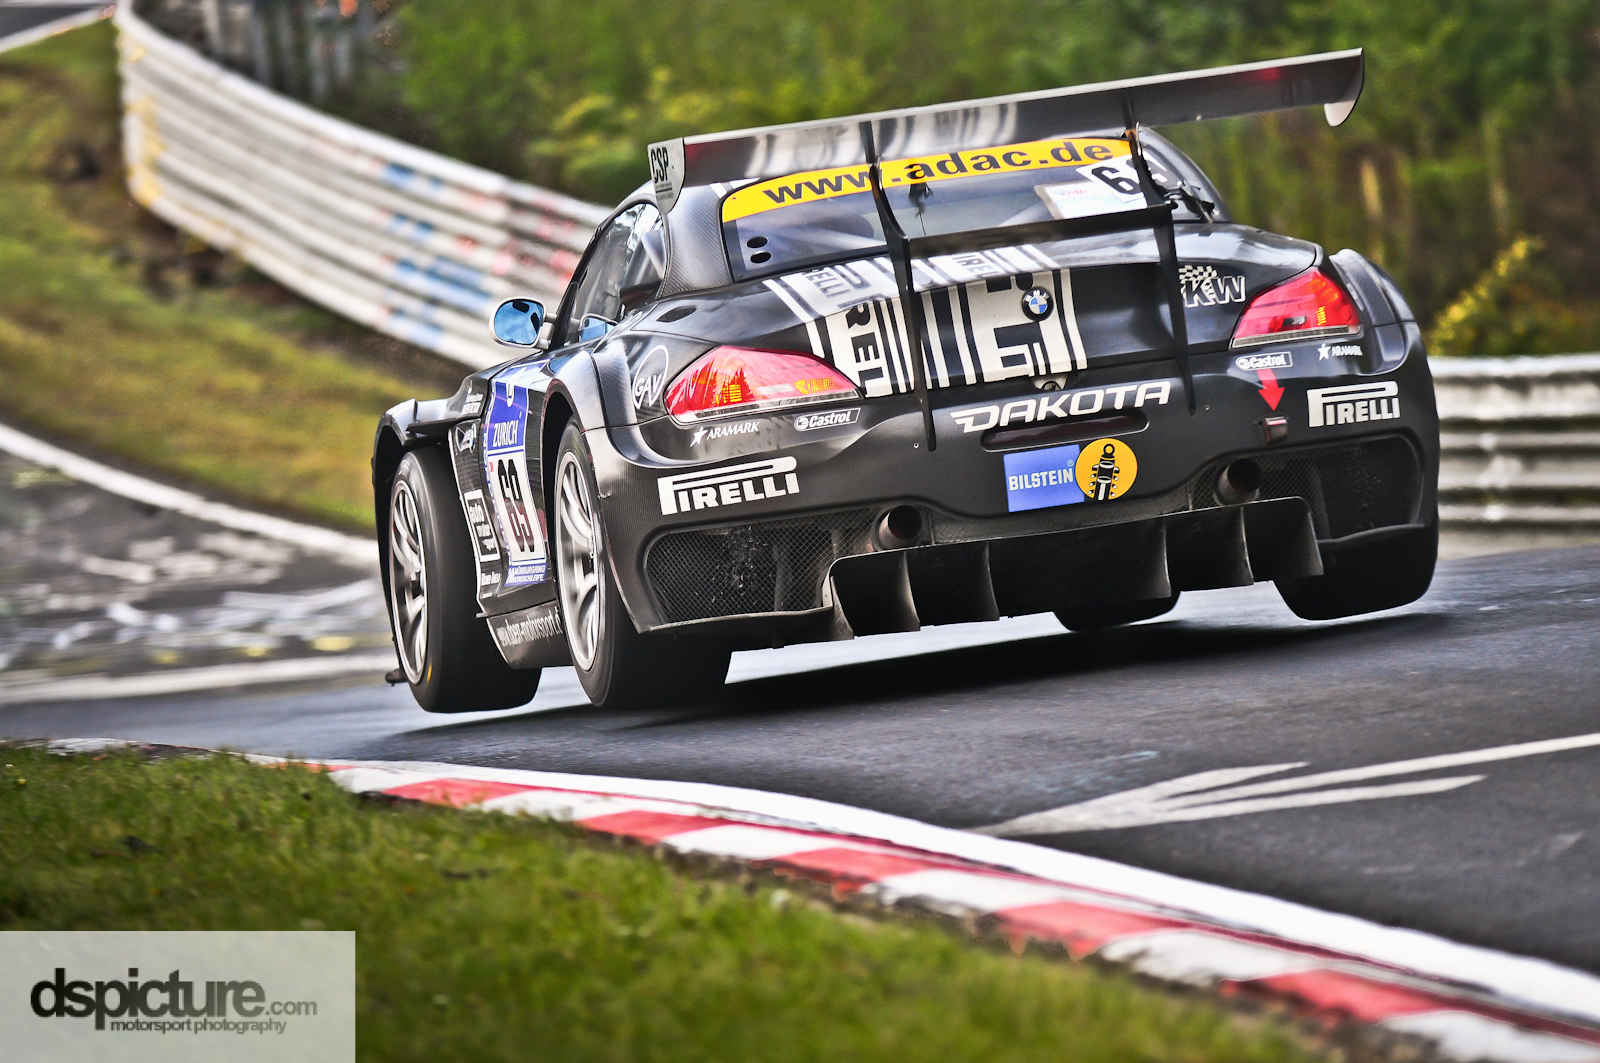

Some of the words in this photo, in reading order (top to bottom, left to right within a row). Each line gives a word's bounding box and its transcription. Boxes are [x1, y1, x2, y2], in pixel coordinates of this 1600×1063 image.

[650, 146, 669, 184] CSP
[762, 141, 1114, 204] www.adac.de
[1024, 289, 1050, 303] BMW
[1184, 275, 1246, 308] KW
[1249, 353, 1287, 369] Castrol
[809, 411, 851, 428] Castrol
[950, 381, 1172, 434] DAKOTA
[1306, 380, 1400, 428] PIRELLI
[492, 419, 520, 448] ZURICH
[706, 421, 761, 441] ARAMARK
[657, 455, 801, 516] PIRELLI
[1008, 467, 1074, 492] BILSTEIN
